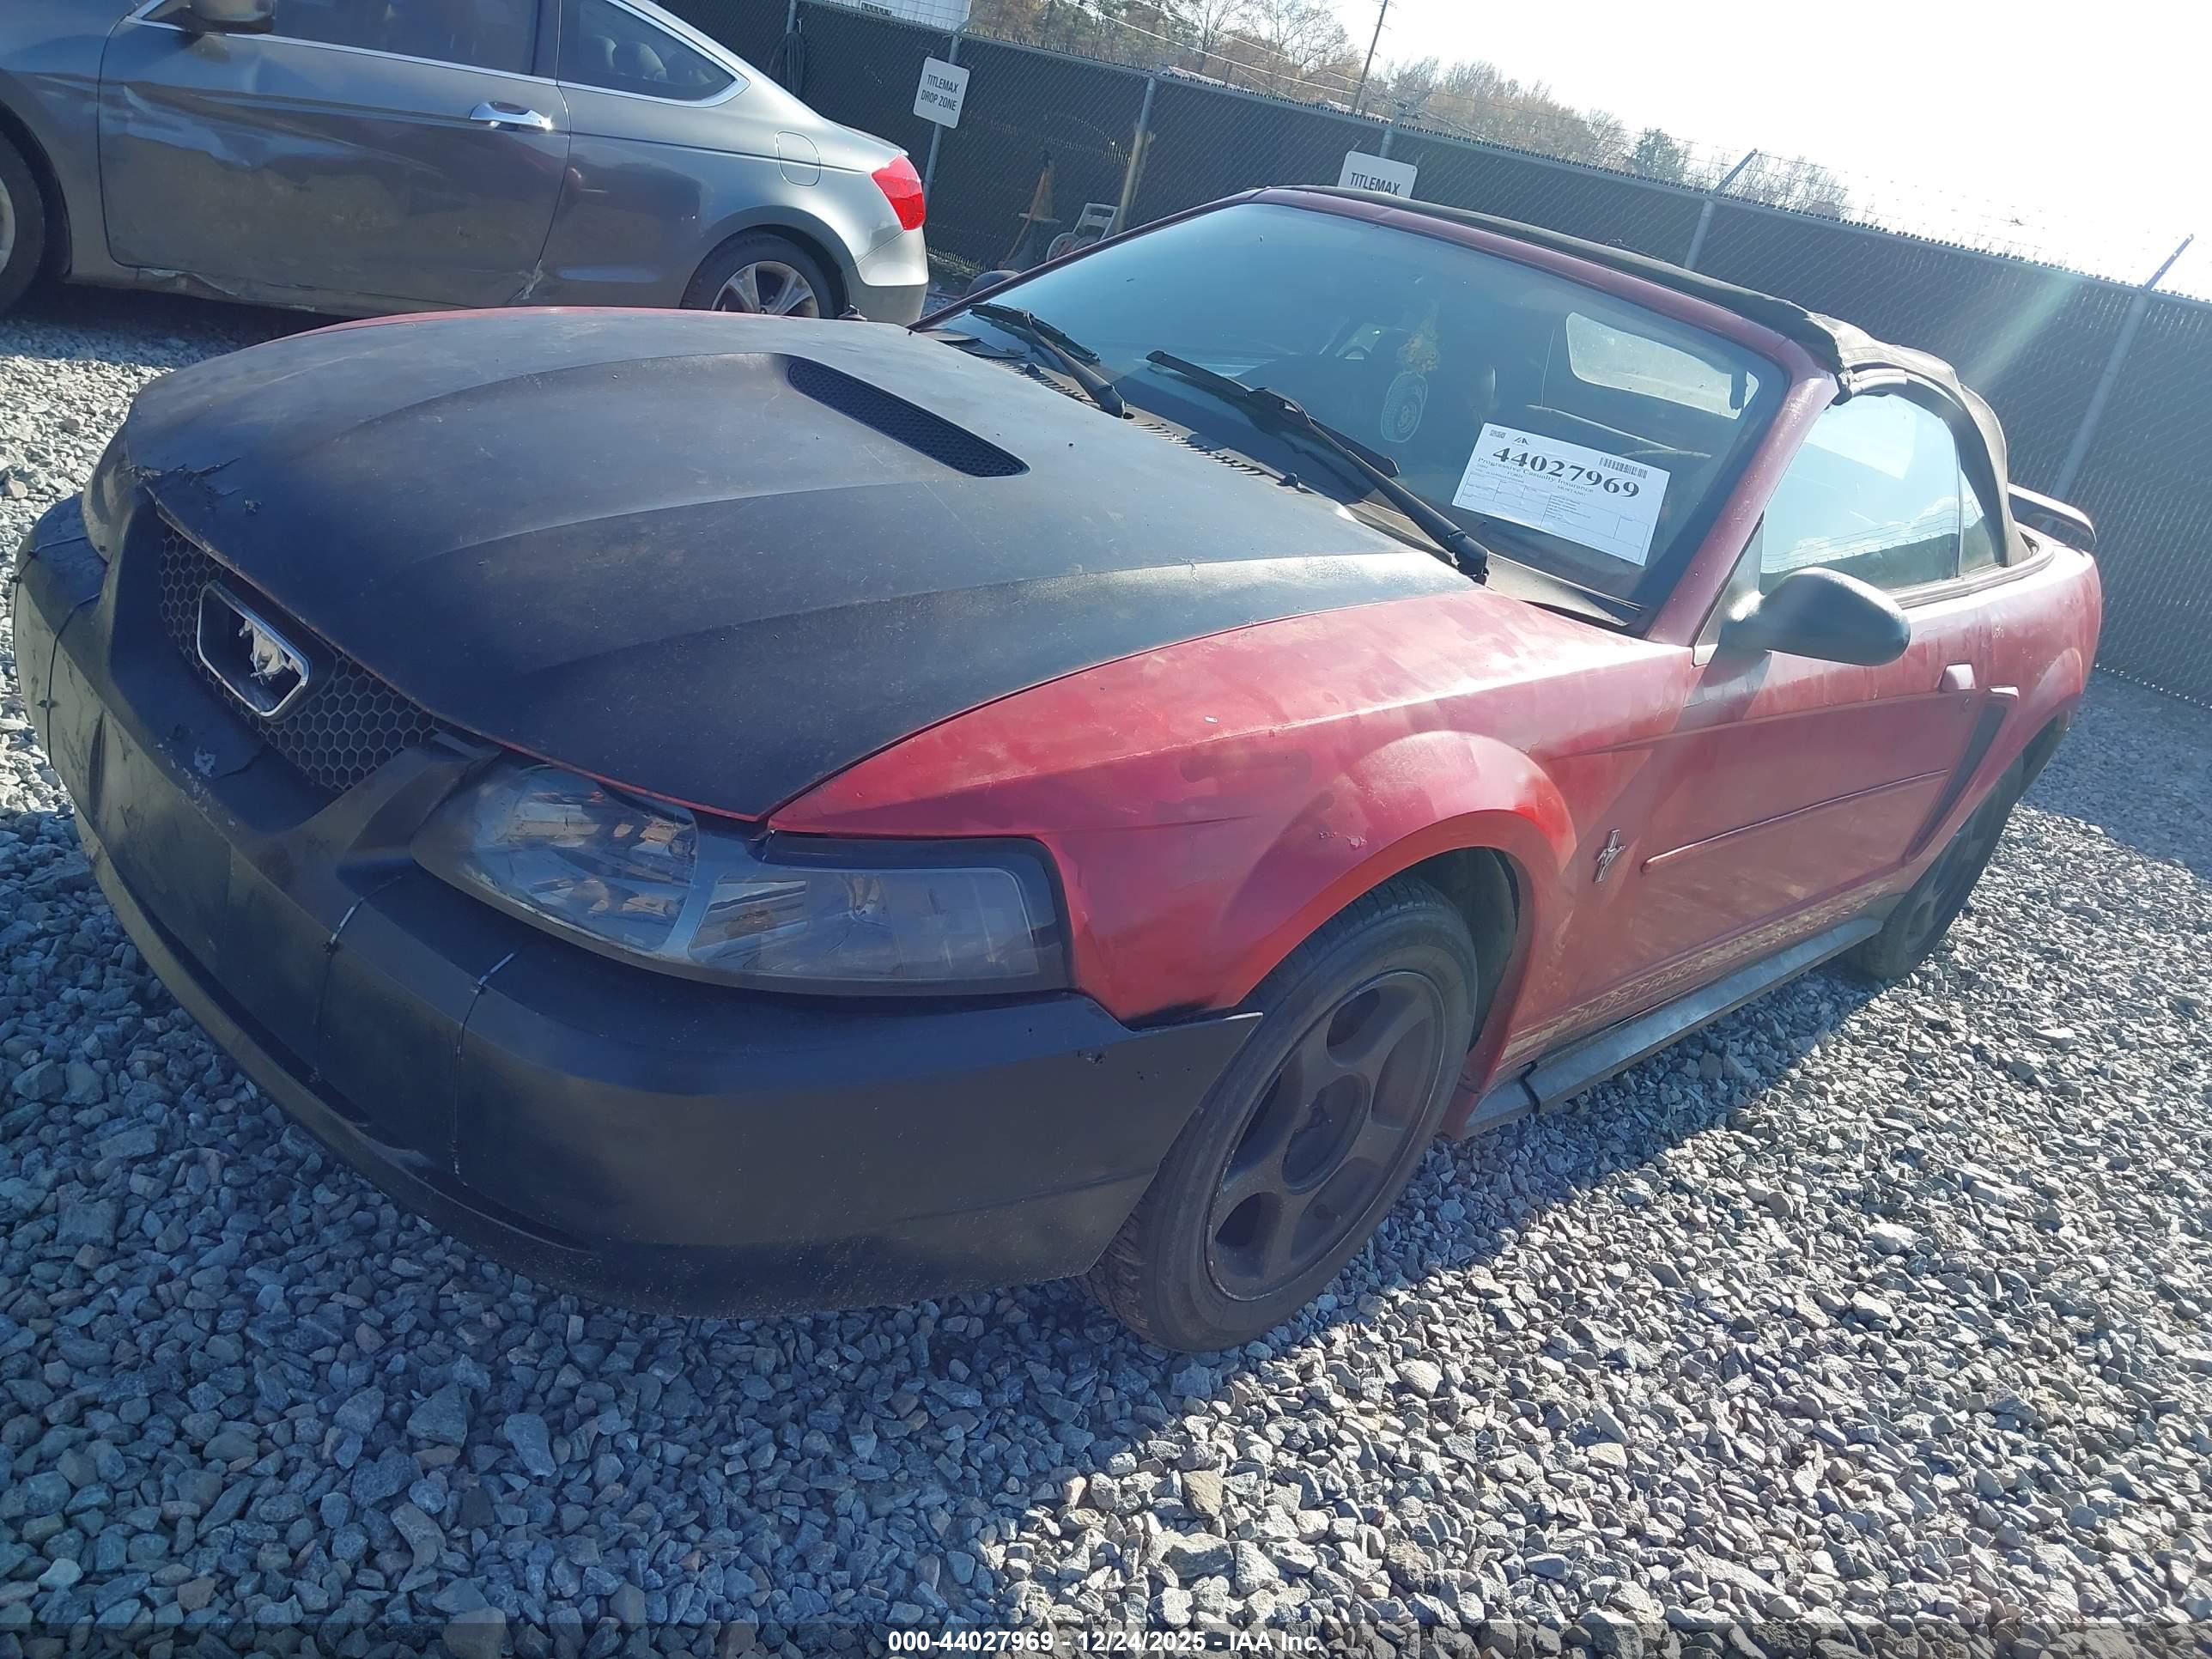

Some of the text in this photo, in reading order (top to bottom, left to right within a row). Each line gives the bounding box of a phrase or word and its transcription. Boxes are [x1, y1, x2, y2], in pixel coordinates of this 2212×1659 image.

[927, 74, 959, 94] TITLEMAX
[921, 89, 958, 112] DROP ZONE
[1350, 172, 1401, 196] TITLEMAX
[1492, 447, 1640, 498] 44027969
